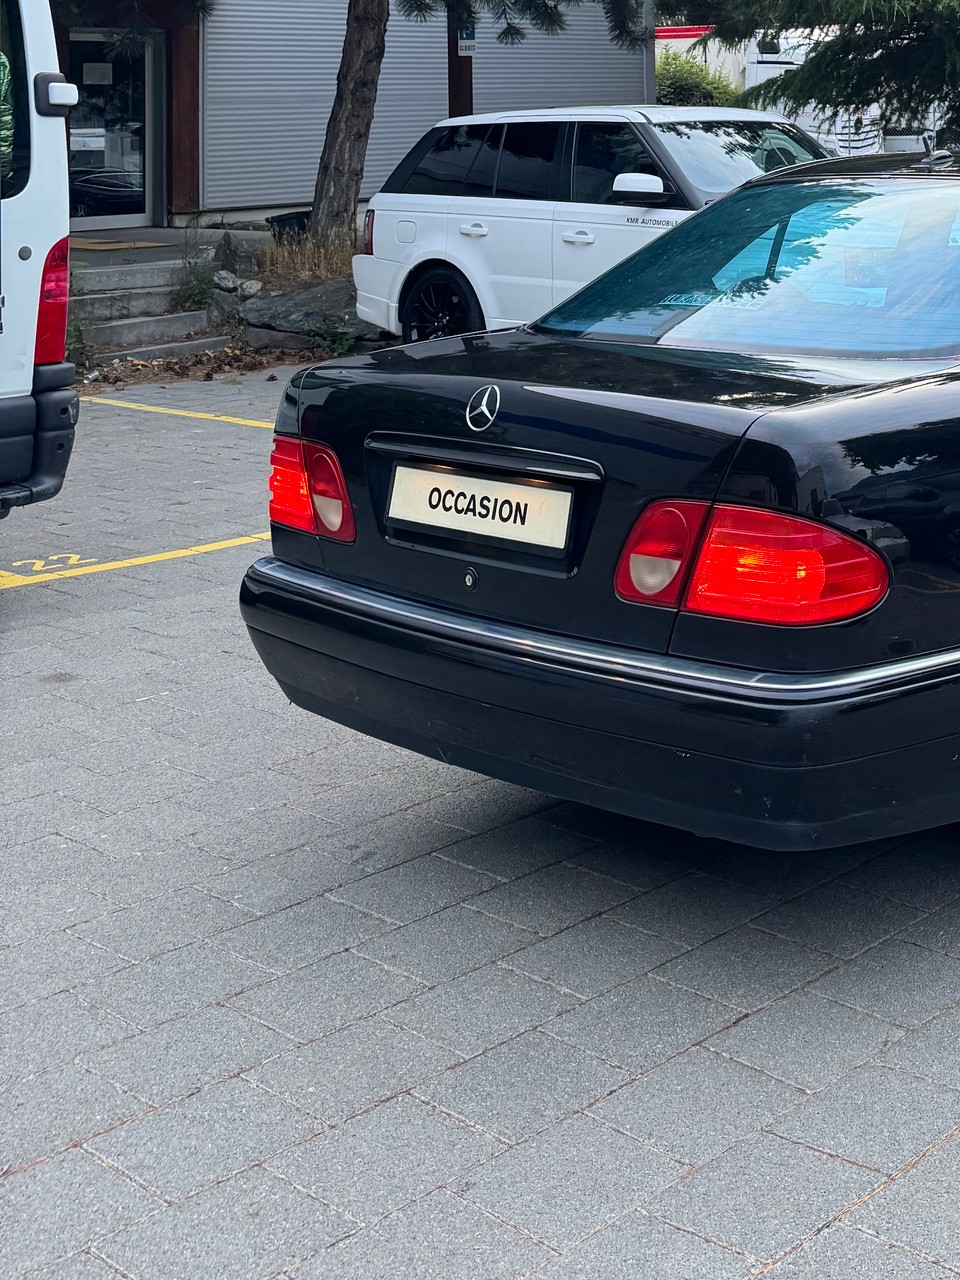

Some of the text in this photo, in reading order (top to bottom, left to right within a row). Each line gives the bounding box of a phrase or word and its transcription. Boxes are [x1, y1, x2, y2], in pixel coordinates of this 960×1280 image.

[625, 217, 639, 225] KMR
[428, 487, 528, 525] OCCASION
[11, 553, 98, 571] 22
